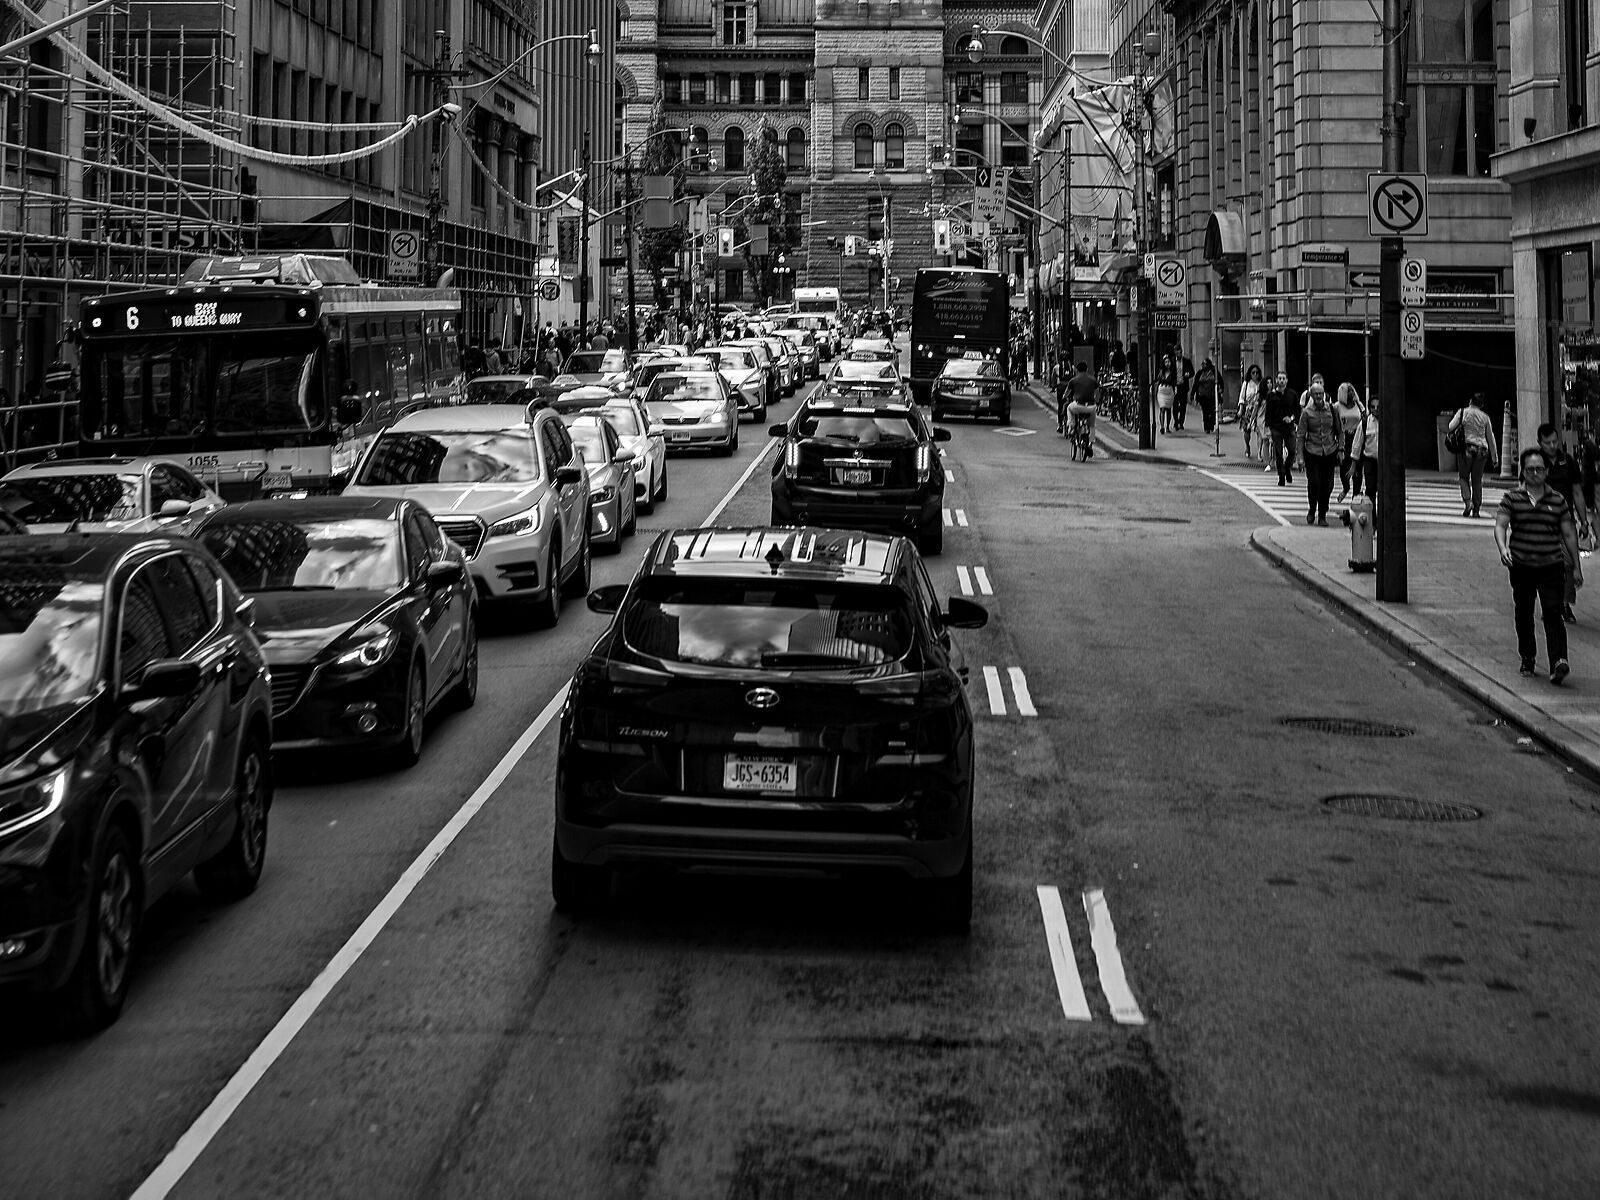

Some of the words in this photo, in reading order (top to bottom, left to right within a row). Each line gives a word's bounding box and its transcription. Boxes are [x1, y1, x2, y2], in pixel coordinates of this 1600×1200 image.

[1304, 253, 1338, 262] Temperance
[194, 302, 217, 316] BAY
[126, 306, 139, 330] 6
[171, 315, 182, 327] TO
[184, 314, 217, 327] QUEENS
[219, 312, 242, 325] QUAY
[187, 455, 219, 467] 1055
[618, 726, 669, 738] TUCSON
[731, 763, 753, 782] JGS
[761, 764, 789, 784] 6354
